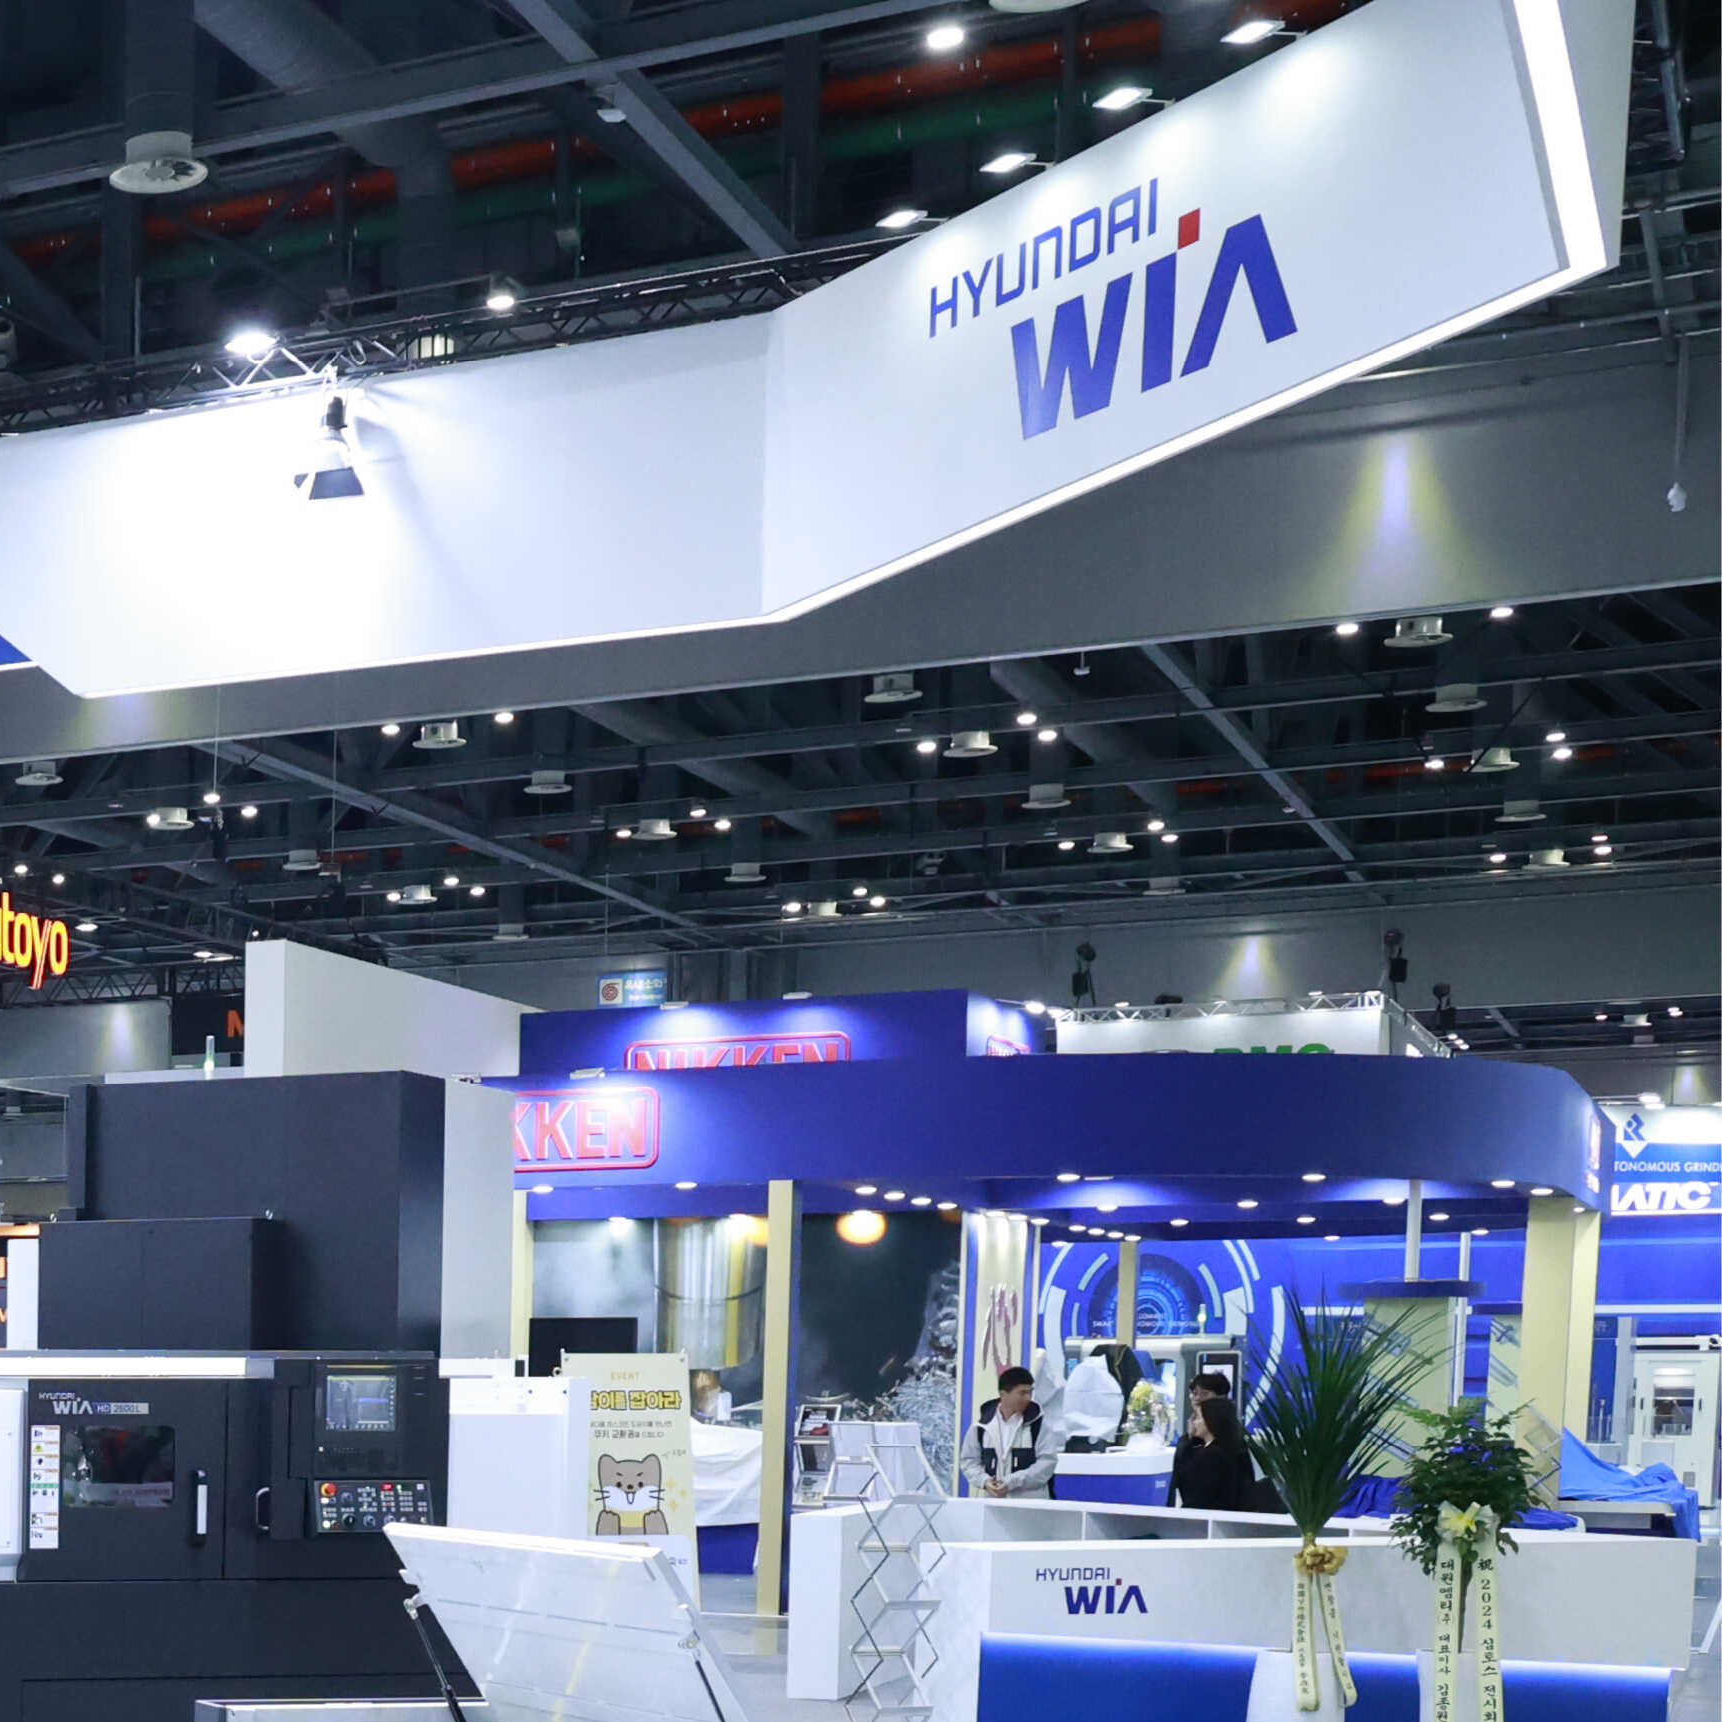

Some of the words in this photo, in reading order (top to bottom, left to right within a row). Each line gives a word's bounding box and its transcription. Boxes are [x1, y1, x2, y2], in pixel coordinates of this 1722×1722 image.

[929, 177, 1159, 338] HYUNDAI
[1011, 208, 1298, 440] WIA
[1684, 1161, 1722, 1172] GRIND
[38, 1392, 76, 1400] HYUNDAI
[628, 1390, 683, 1411] 잡아라
[1035, 1567, 1111, 1582] HYUNDAI
[1477, 1558, 1494, 1571] 祝
[1064, 1577, 1149, 1615] WIA
[1480, 1578, 1493, 1630] 2024
